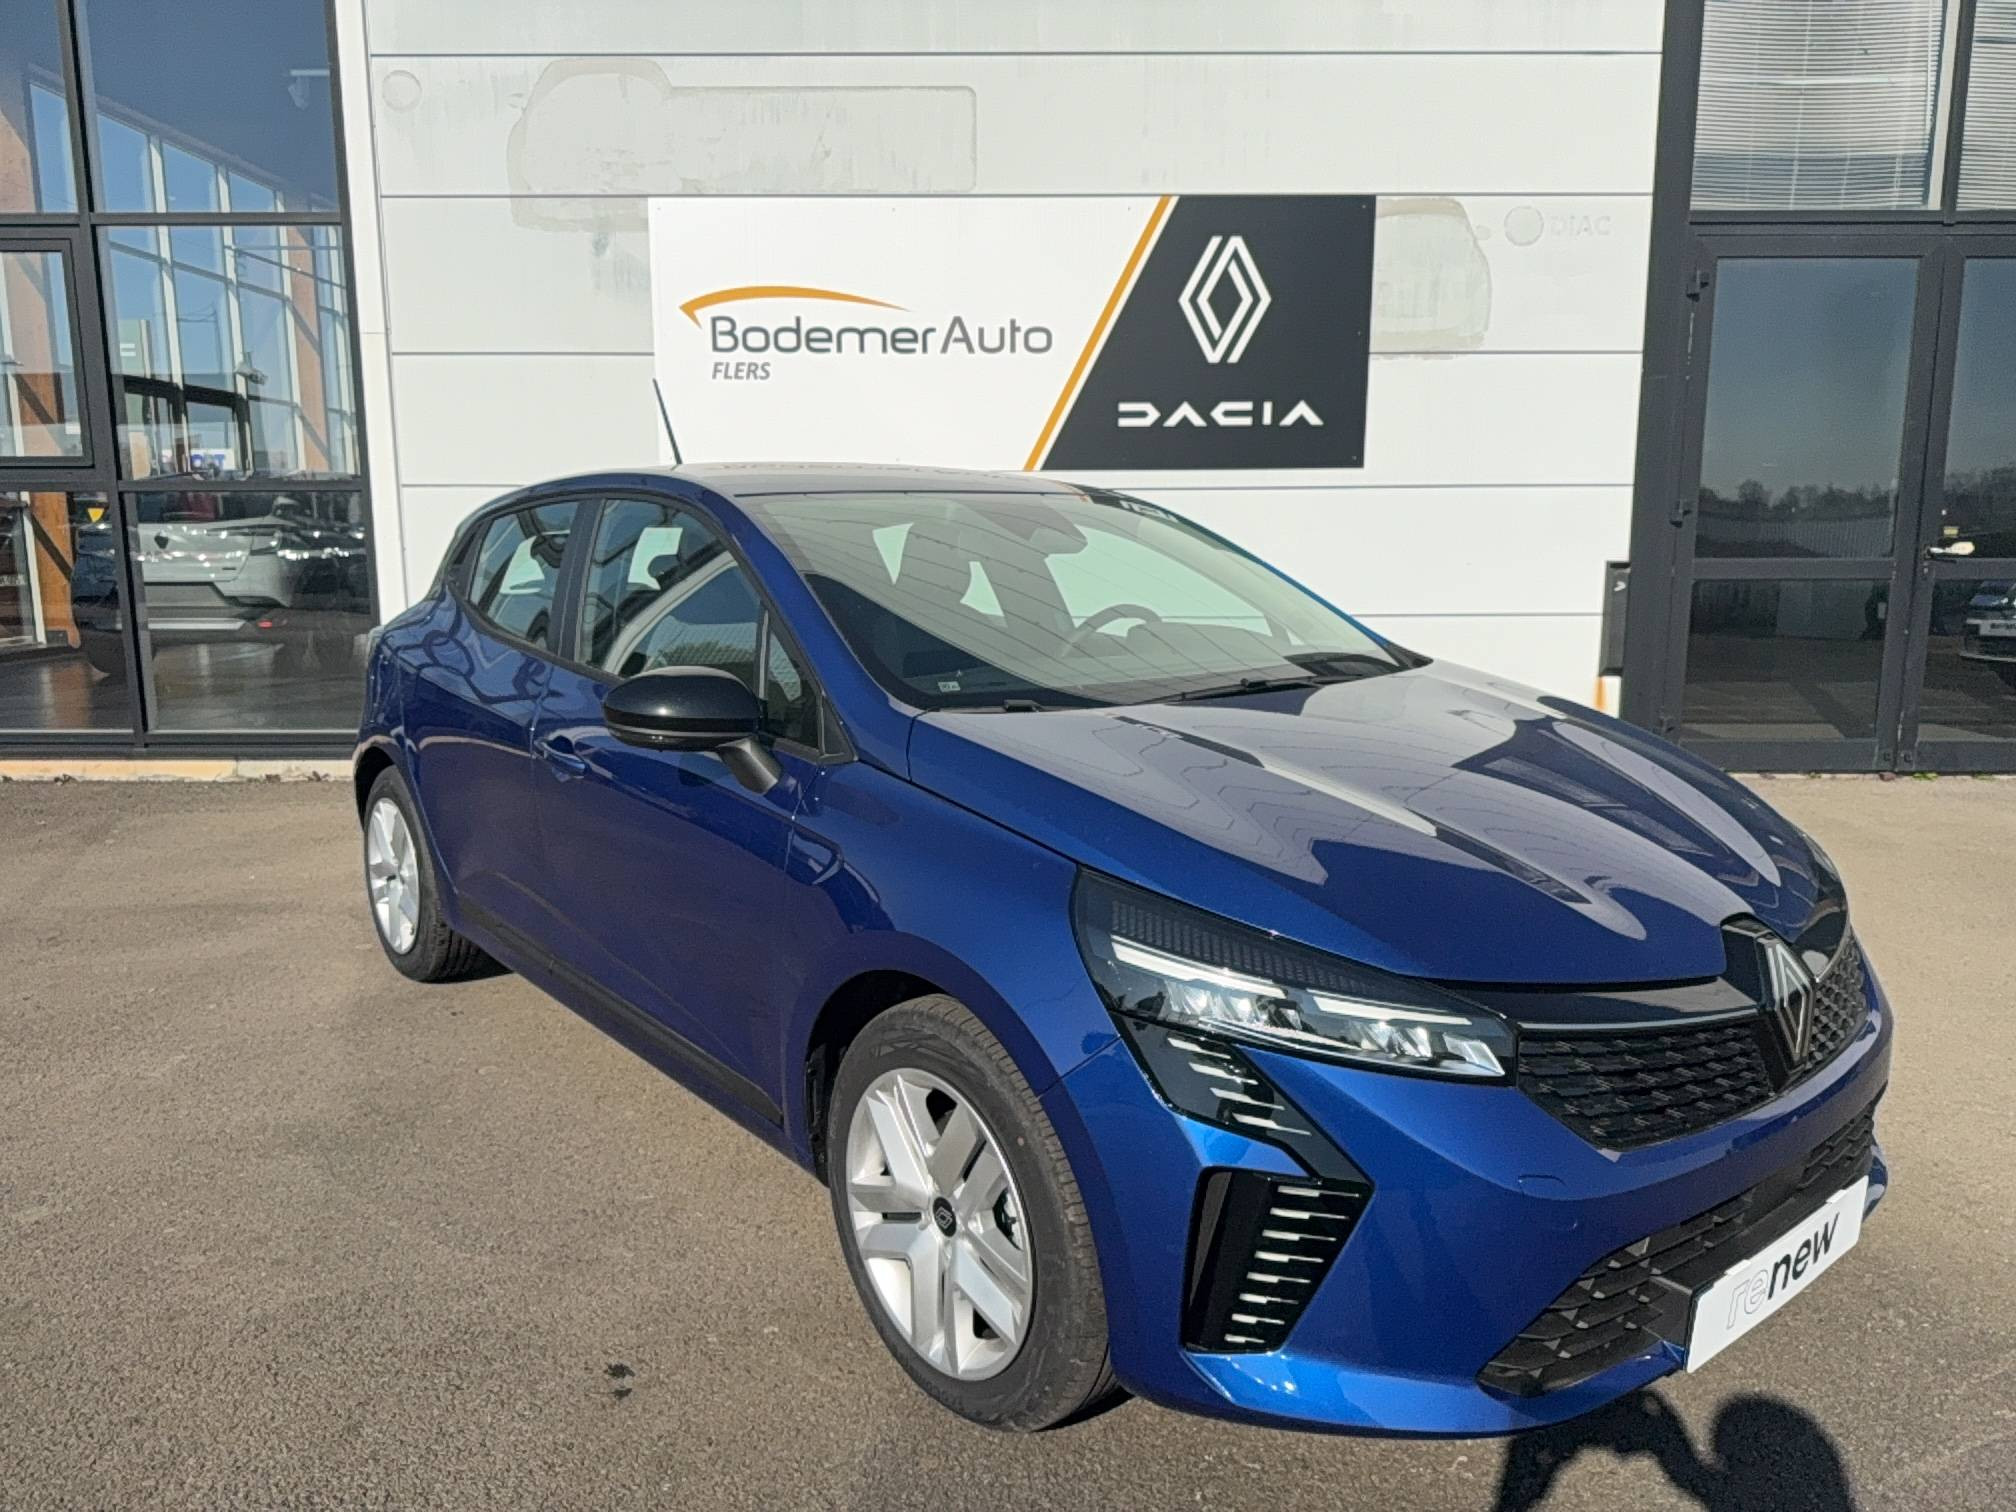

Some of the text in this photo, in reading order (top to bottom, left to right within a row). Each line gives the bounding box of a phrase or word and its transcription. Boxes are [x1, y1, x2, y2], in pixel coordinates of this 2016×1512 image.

[712, 361, 771, 380] FLERS
[1117, 400, 1324, 428] DACIA
[1726, 1212, 1840, 1331] renew
